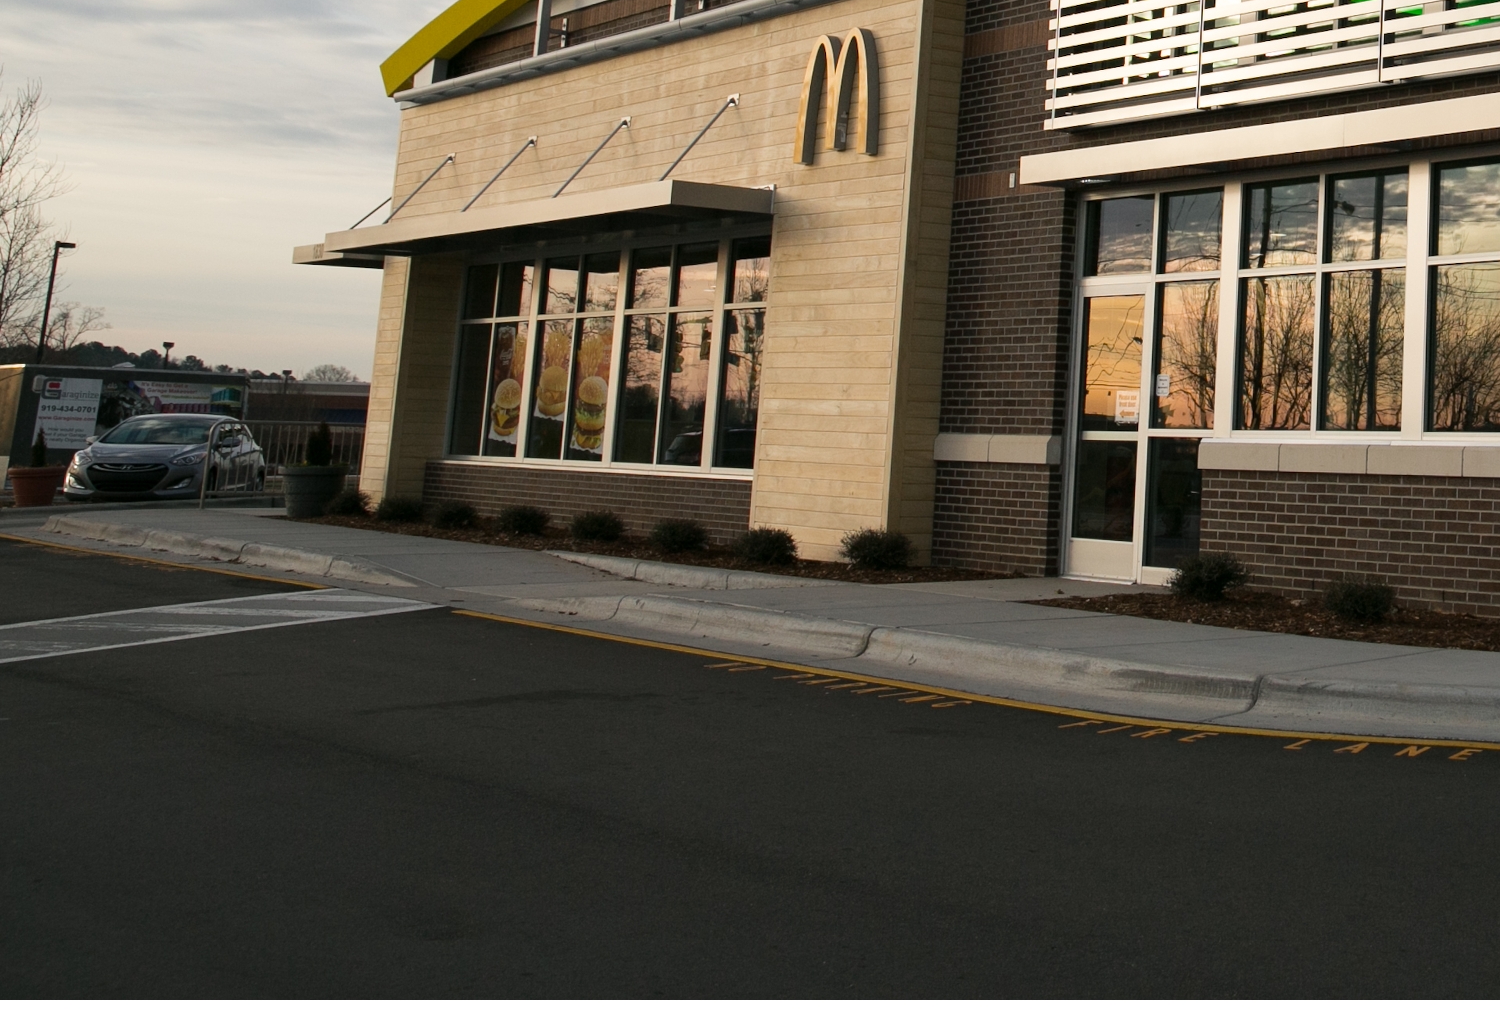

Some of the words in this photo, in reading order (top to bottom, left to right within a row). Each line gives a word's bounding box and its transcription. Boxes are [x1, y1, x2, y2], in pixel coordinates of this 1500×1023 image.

[41, 404, 96, 413] 919-434-0701
[772, 674, 973, 709] PARKING
[1057, 720, 1220, 744] FIRE
[1282, 739, 1483, 761] LANE
